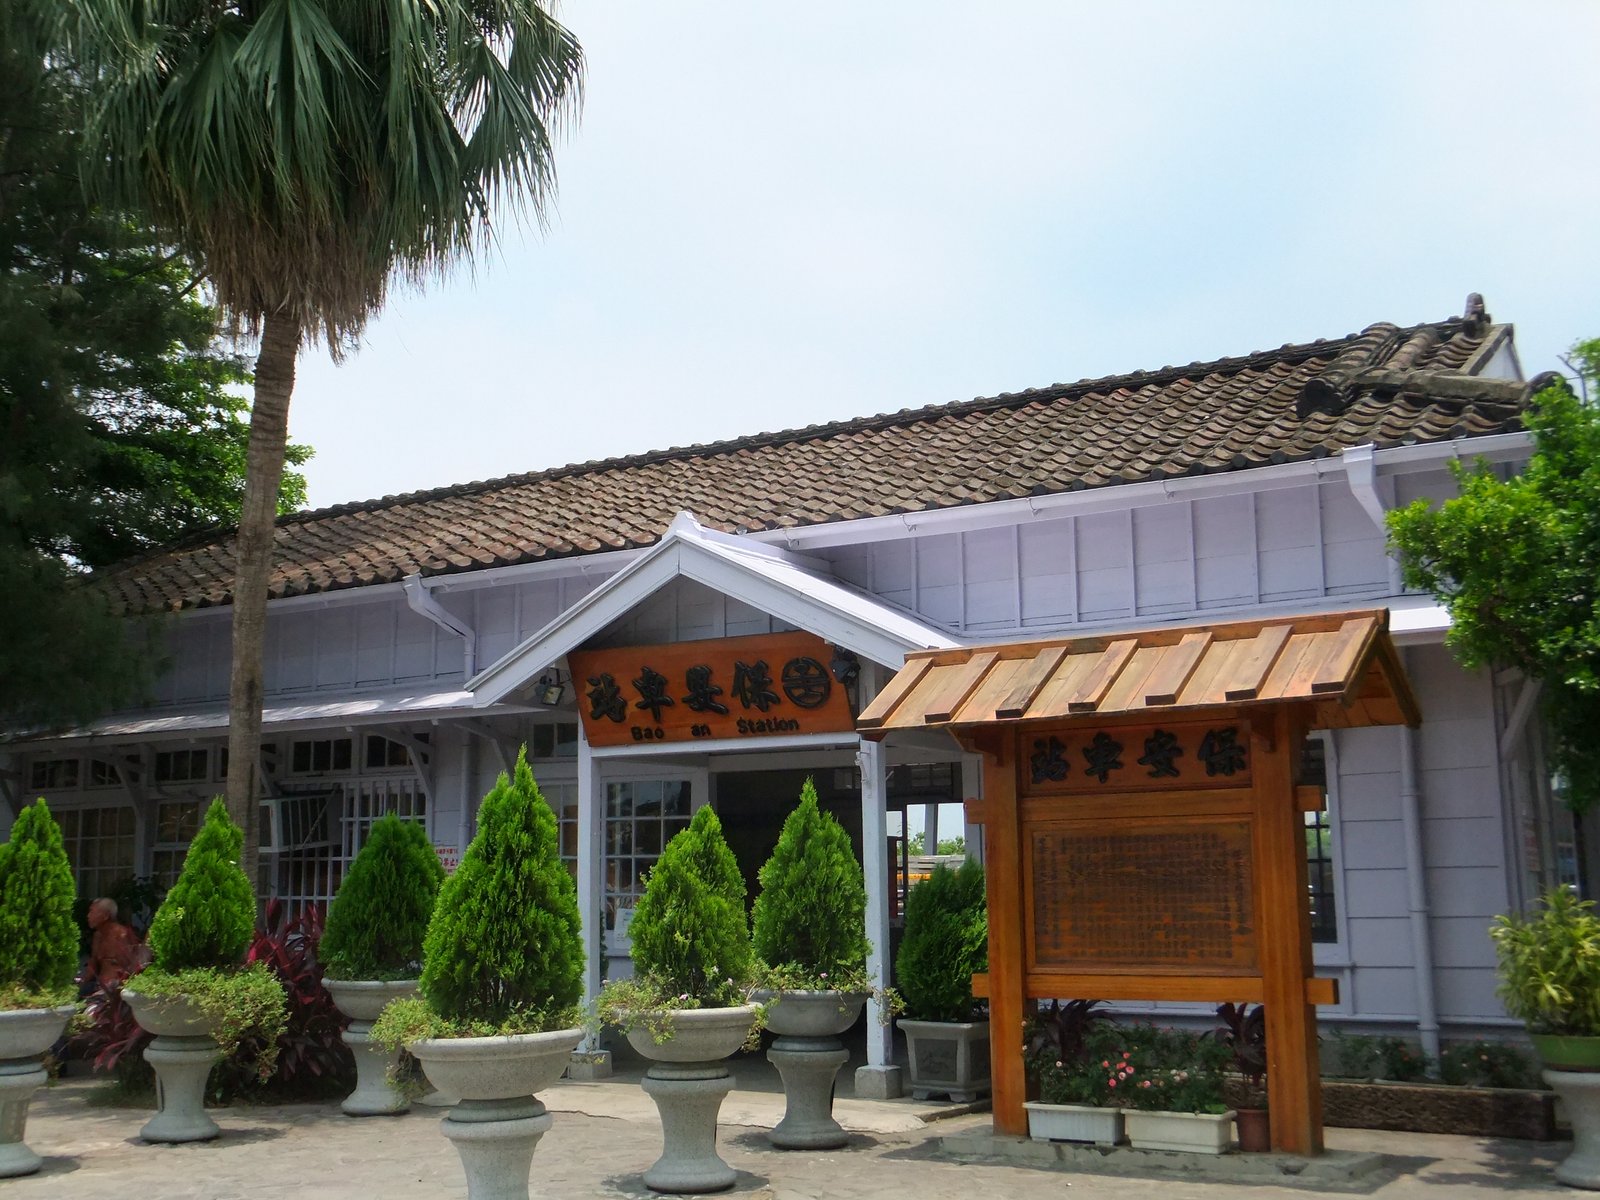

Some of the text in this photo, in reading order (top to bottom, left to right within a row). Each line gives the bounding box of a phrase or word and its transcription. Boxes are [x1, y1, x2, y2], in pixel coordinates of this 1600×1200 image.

[631, 716, 799, 741] Bao an Station
